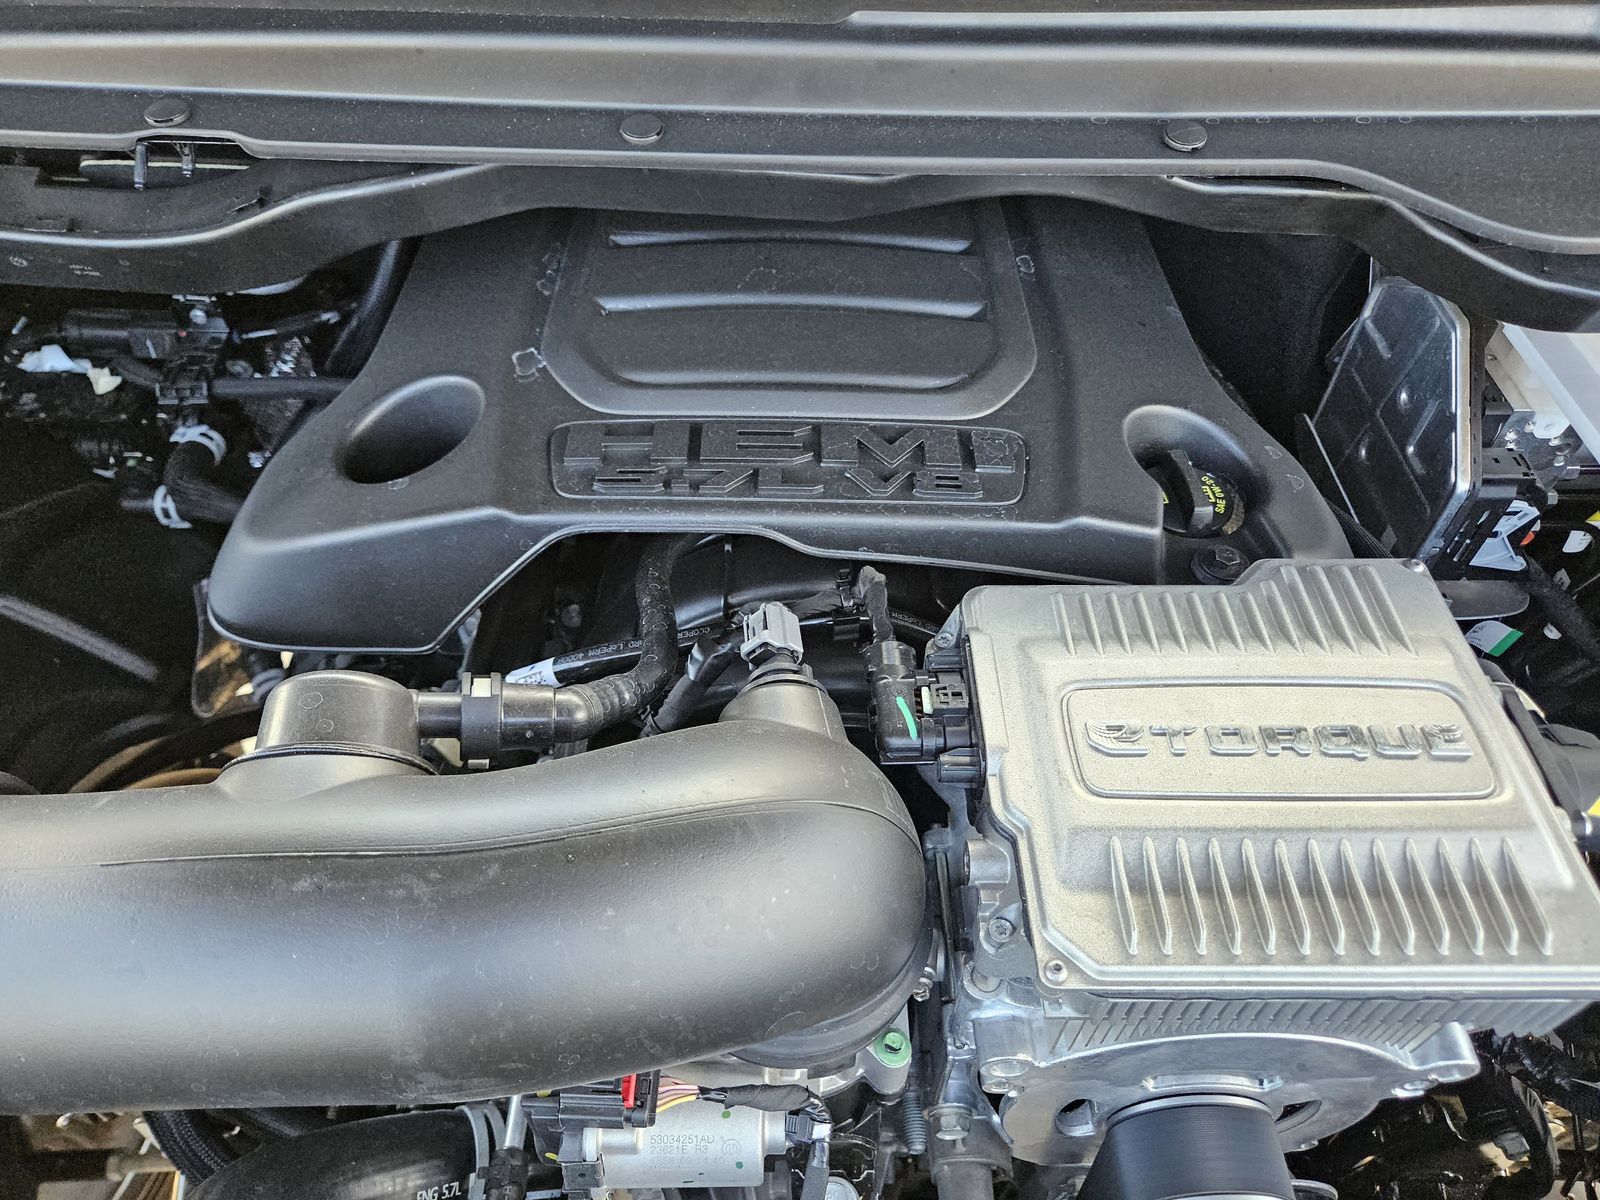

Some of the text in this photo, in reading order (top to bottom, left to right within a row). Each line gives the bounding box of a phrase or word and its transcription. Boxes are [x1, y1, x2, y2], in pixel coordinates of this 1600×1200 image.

[563, 420, 1015, 474] HEMI
[845, 468, 984, 498] V8
[1201, 476, 1226, 514] SAE 0W-20
[441, 1181, 461, 1199] 5.7L
